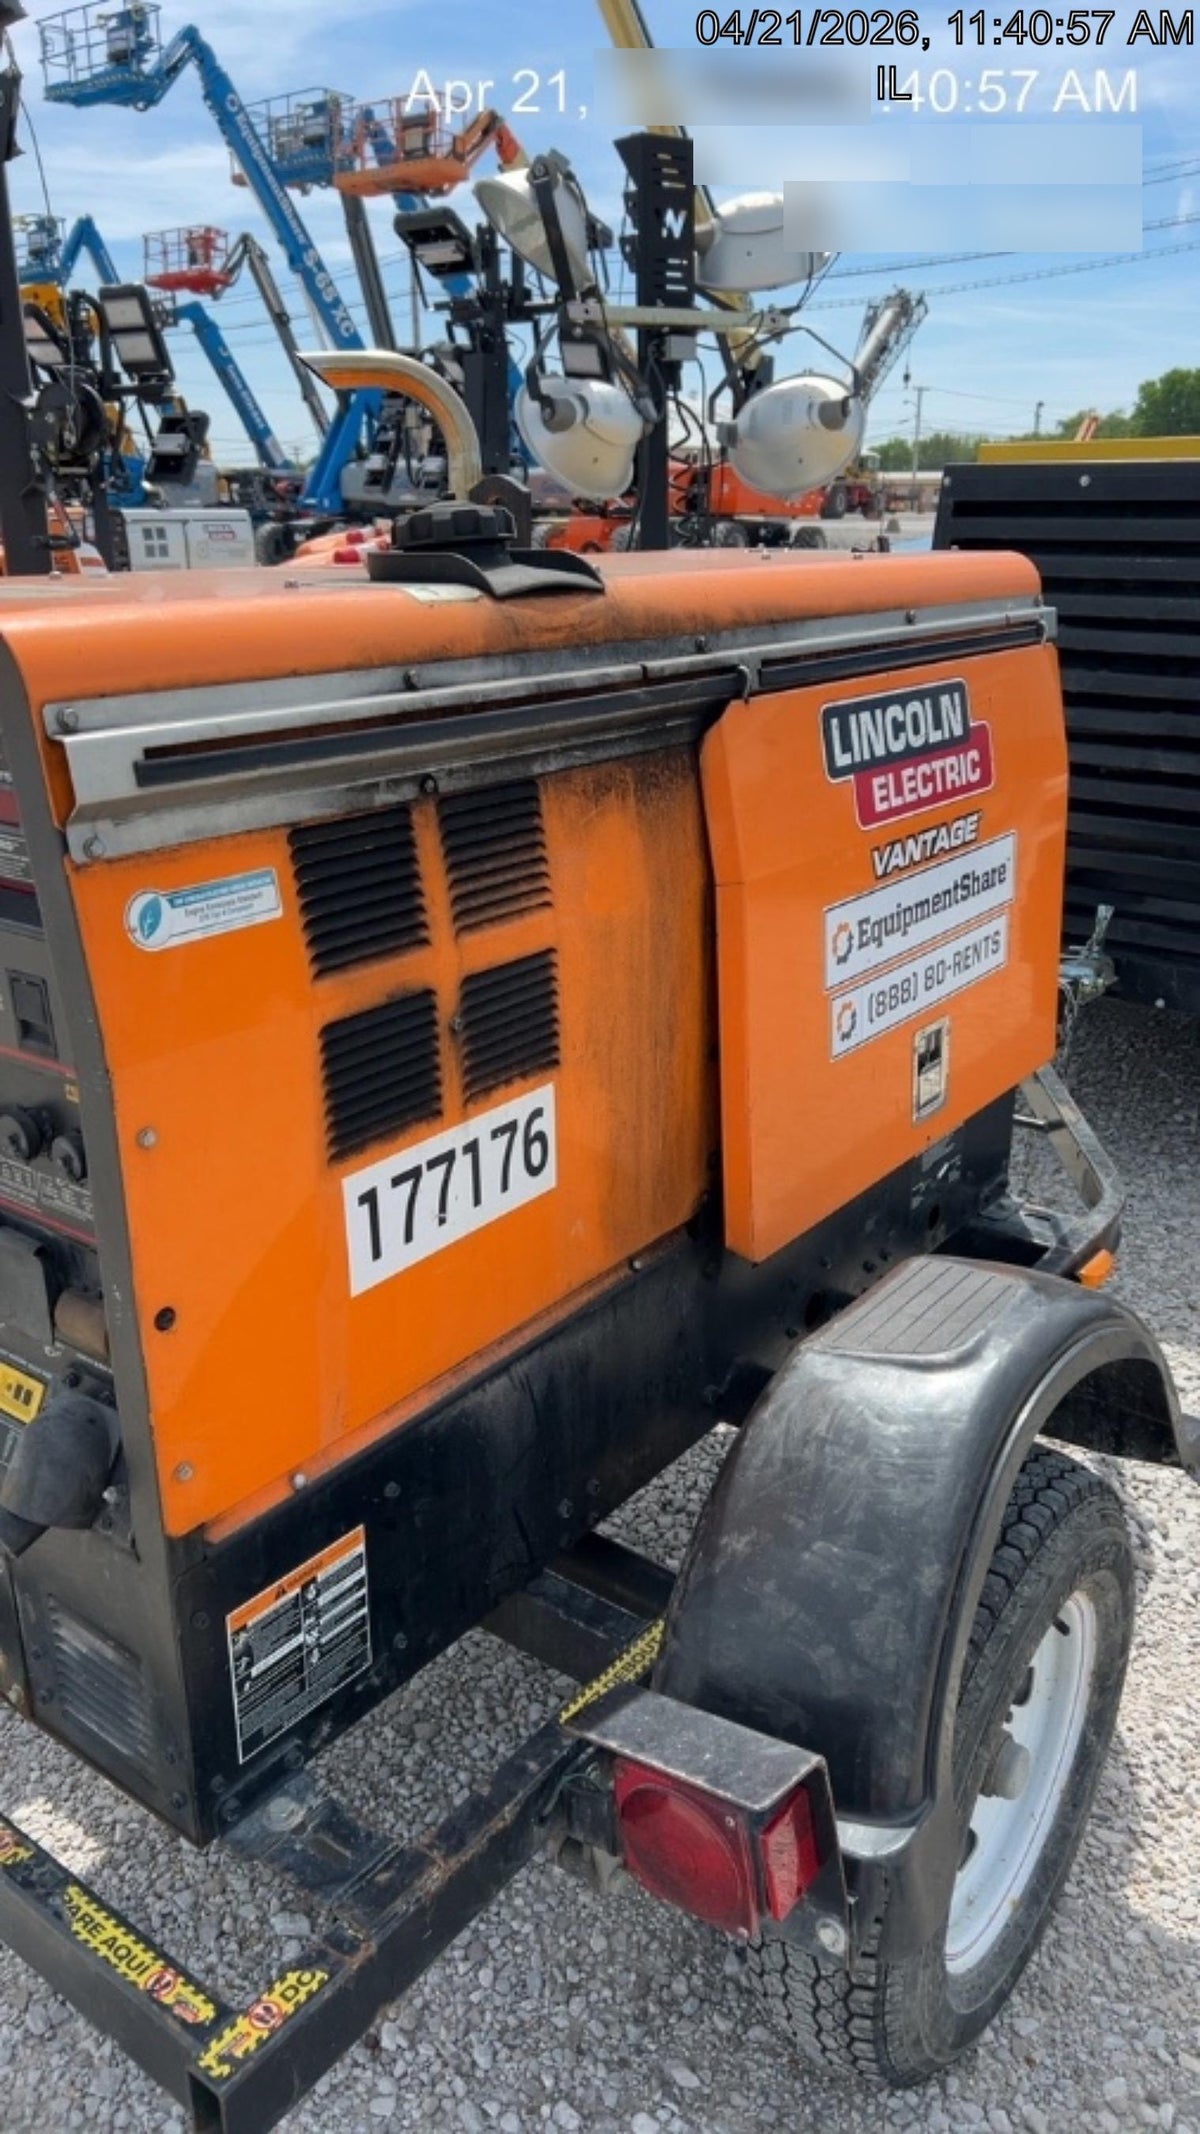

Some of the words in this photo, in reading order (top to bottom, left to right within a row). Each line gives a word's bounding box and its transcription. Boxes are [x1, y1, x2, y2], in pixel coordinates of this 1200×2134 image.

[330, 302, 354, 338] XC
[829, 691, 964, 768] LINCOLN
[871, 749, 981, 814] ELECTRIC
[872, 812, 981, 879] VANTAGE
[857, 864, 1007, 952] EquipmentShare
[867, 971, 919, 1025] (888)
[923, 929, 1001, 992] 80-RENTS
[357, 1106, 549, 1262] 177176
